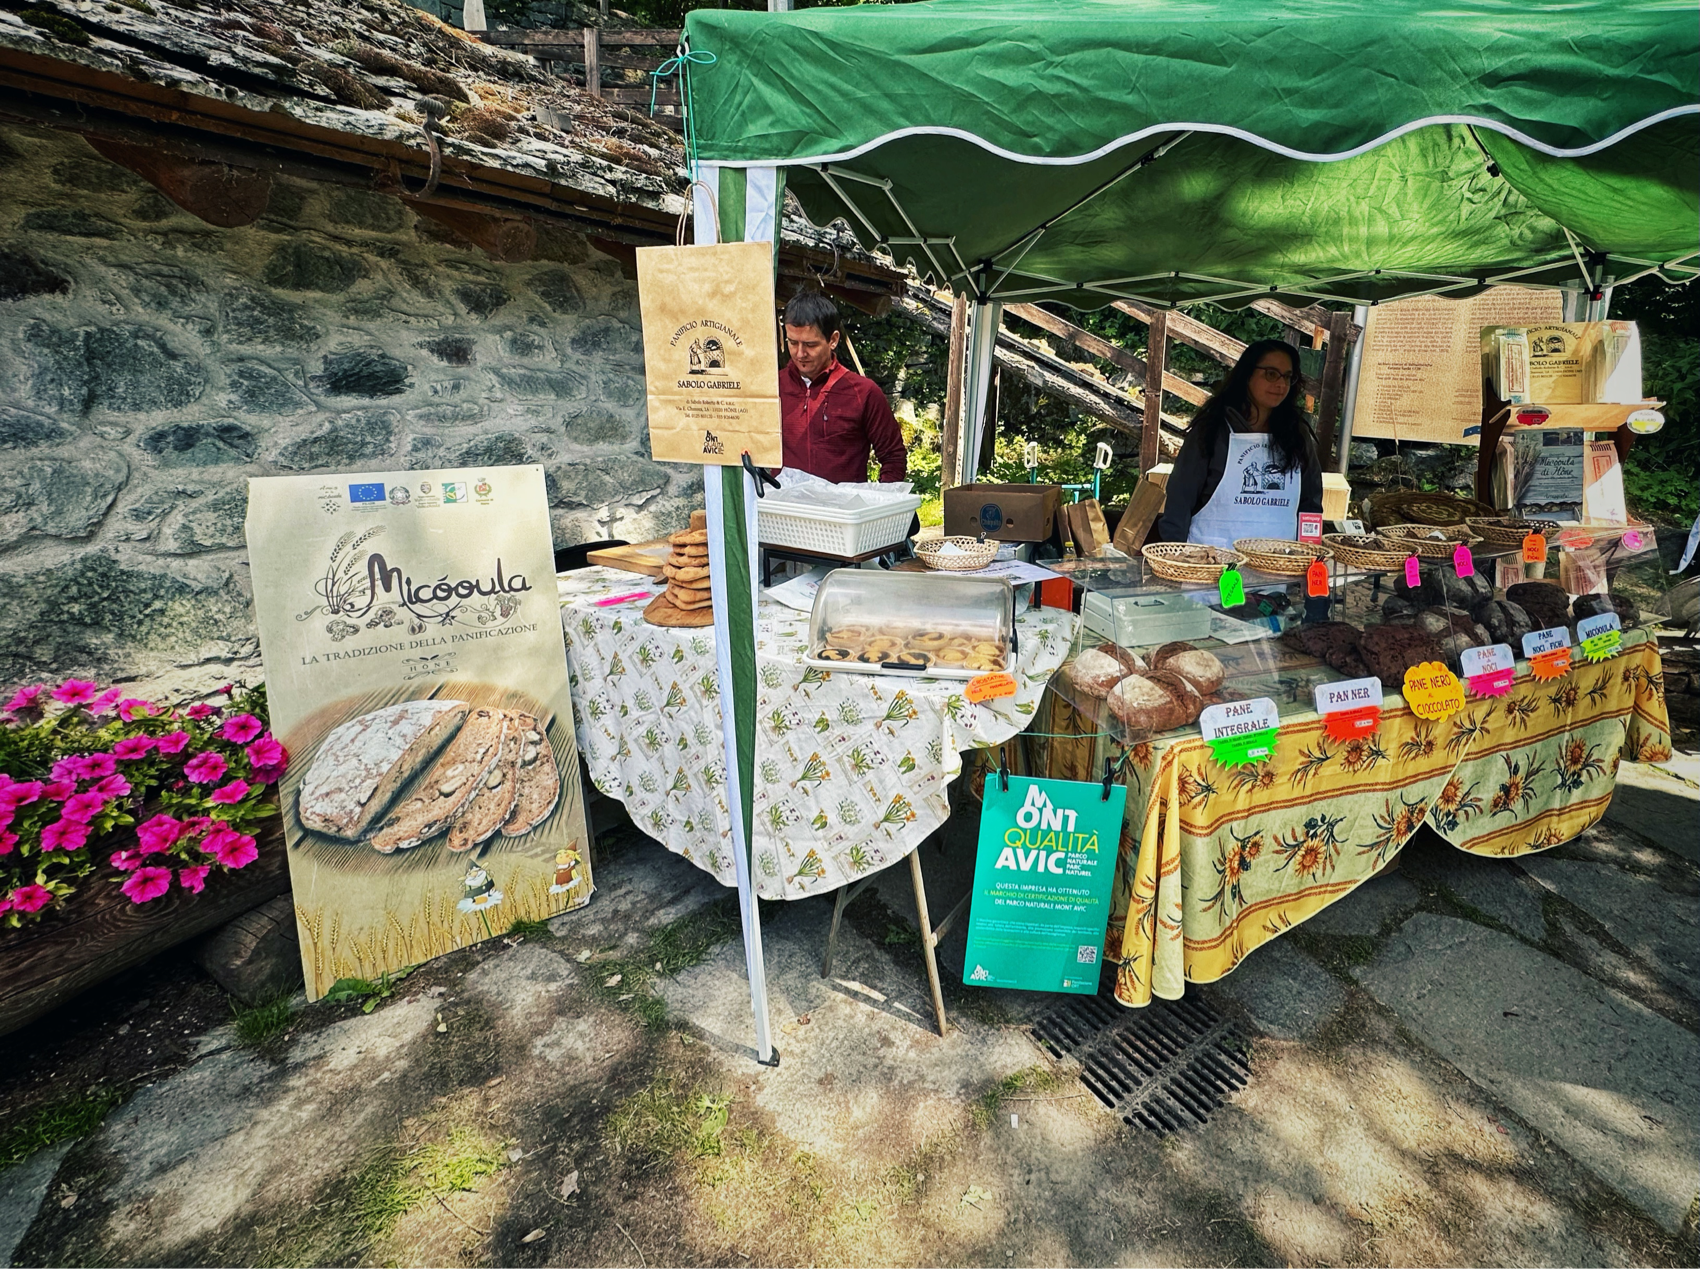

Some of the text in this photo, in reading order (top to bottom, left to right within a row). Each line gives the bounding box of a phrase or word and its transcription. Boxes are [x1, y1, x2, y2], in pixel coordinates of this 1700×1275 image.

[670, 319, 743, 348] PANIFICIO ARTIGIANALE
[1544, 326, 1581, 340] ARTIGIANALE
[678, 380, 741, 390] SABOLO GABRIELE
[702, 446, 718, 454] AVIC
[1238, 443, 1260, 465] PANIFICIO
[1234, 496, 1290, 507] SABOLO GABRIELE
[1538, 630, 1553, 640] PANE
[301, 623, 538, 666] LA TRADIZIONE DELLA PANIFICAZIONE
[1532, 646, 1546, 654] NOCI
[1477, 648, 1496, 660] PANE
[409, 660, 451, 672] HÔNE
[1482, 663, 1498, 674] NOCI
[1408, 674, 1452, 693] PANE NERO
[1329, 687, 1371, 704] PAN NER
[1225, 703, 1253, 718] PANE
[1416, 699, 1460, 716] CIOCCOLATO
[1214, 718, 1270, 739] INTEGRALE
[1004, 828, 1099, 854] QUALITÀ
[994, 847, 1066, 874] AVIC
[1067, 858, 1097, 866] NATURALE
[1066, 869, 1091, 877] NATUREL
[996, 882, 1019, 890] QUESTA
[1020, 884, 1046, 892] IMPRESA
[1058, 887, 1090, 896] OTTENUTO
[990, 890, 1017, 898] MARCHIO
[1024, 893, 1067, 902] CERTIFICAZIONE
[1076, 896, 1099, 905] QUALITÀ
[1006, 899, 1024, 907] PARCO
[1025, 901, 1053, 909] NATURALE
[1055, 903, 1072, 911] MONT
[1073, 904, 1087, 912] AVIC
